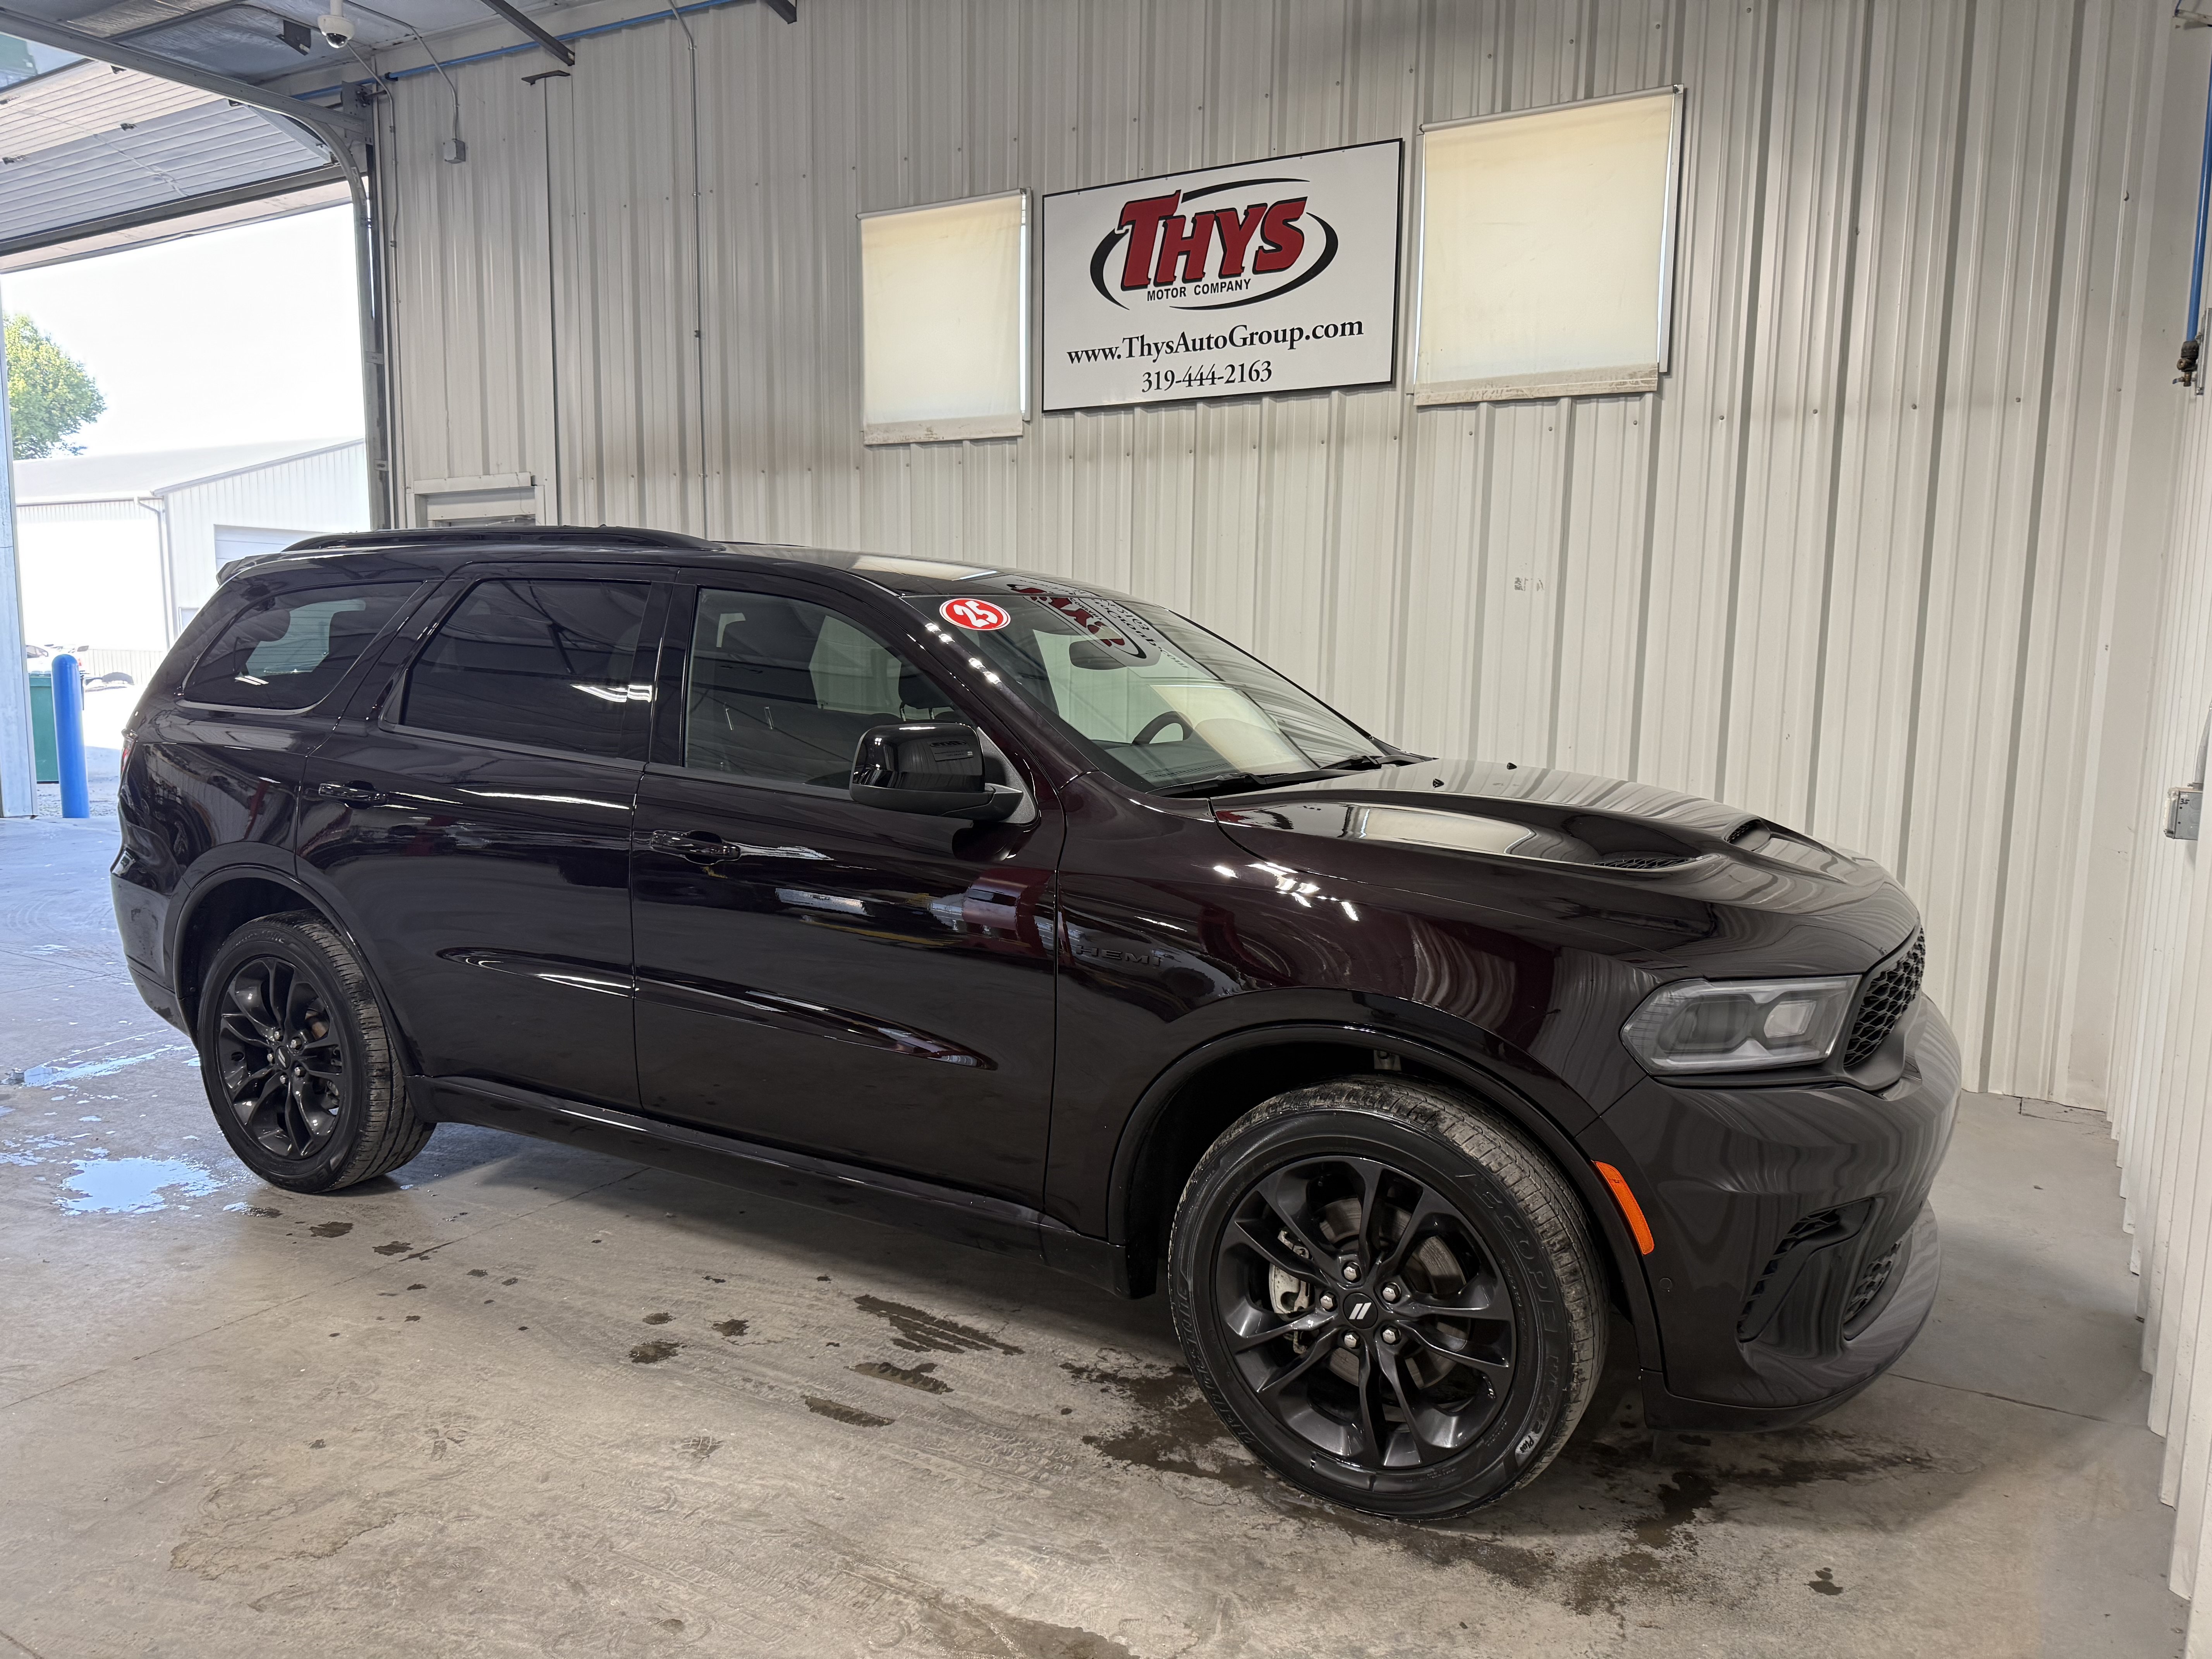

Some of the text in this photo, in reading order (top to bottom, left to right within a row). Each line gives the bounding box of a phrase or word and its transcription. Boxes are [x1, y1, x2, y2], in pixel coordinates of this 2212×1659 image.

[1114, 189, 1308, 291] THYS
[1147, 278, 1251, 302] MOTOR COMPANY
[1067, 321, 1364, 364] www.ThysAutoGroup.com
[1142, 360, 1273, 393] 319-444-2163
[955, 600, 999, 628] 25
[1075, 945, 1162, 966] HEMI
[1520, 1434, 1535, 1453] Plus
